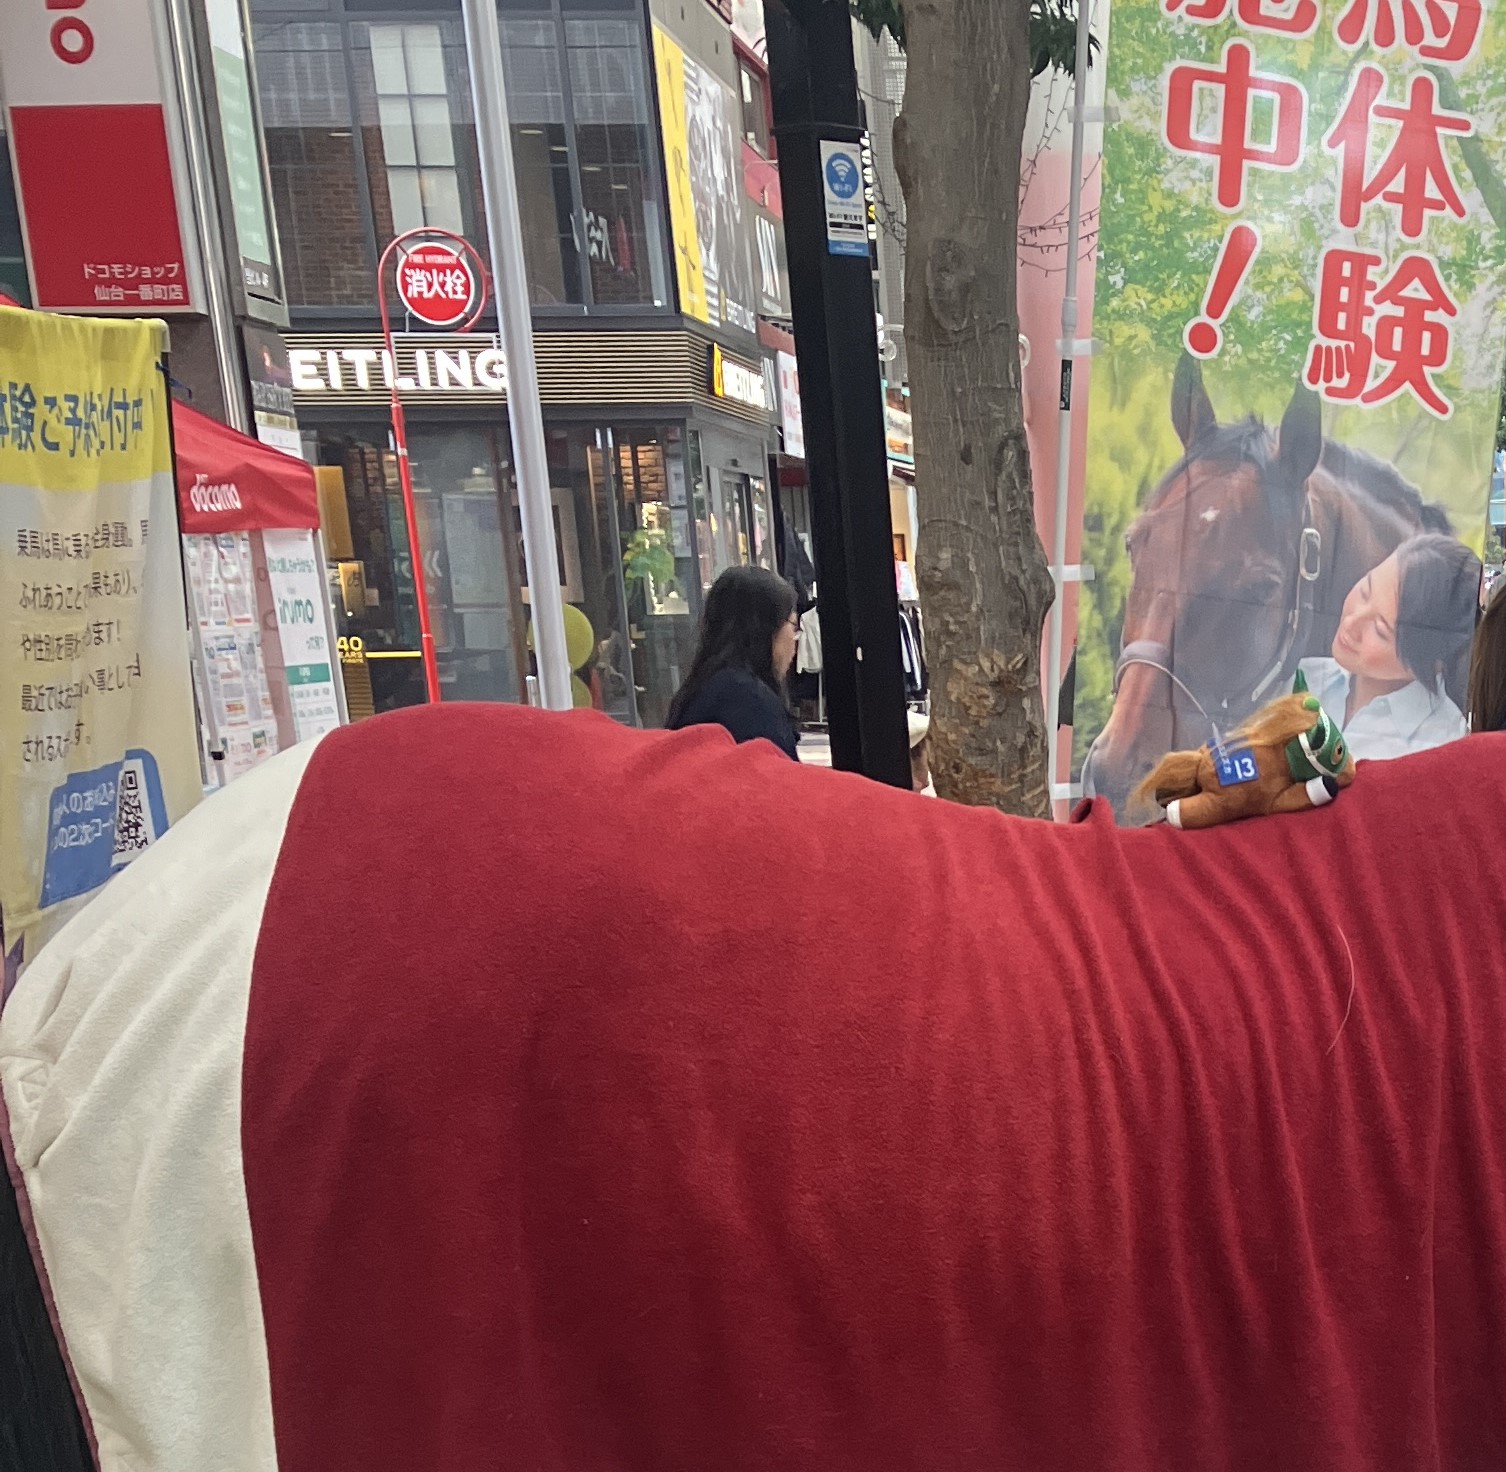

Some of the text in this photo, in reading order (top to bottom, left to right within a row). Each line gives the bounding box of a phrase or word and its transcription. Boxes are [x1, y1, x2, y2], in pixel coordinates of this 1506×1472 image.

[83, 262, 180, 279] ドコモショップ
[94, 284, 184, 300] 仙台一番町店
[404, 267, 468, 300] 消火栓
[190, 474, 242, 512] docomo
[336, 636, 363, 651] 40
[1234, 757, 1256, 780] 13
